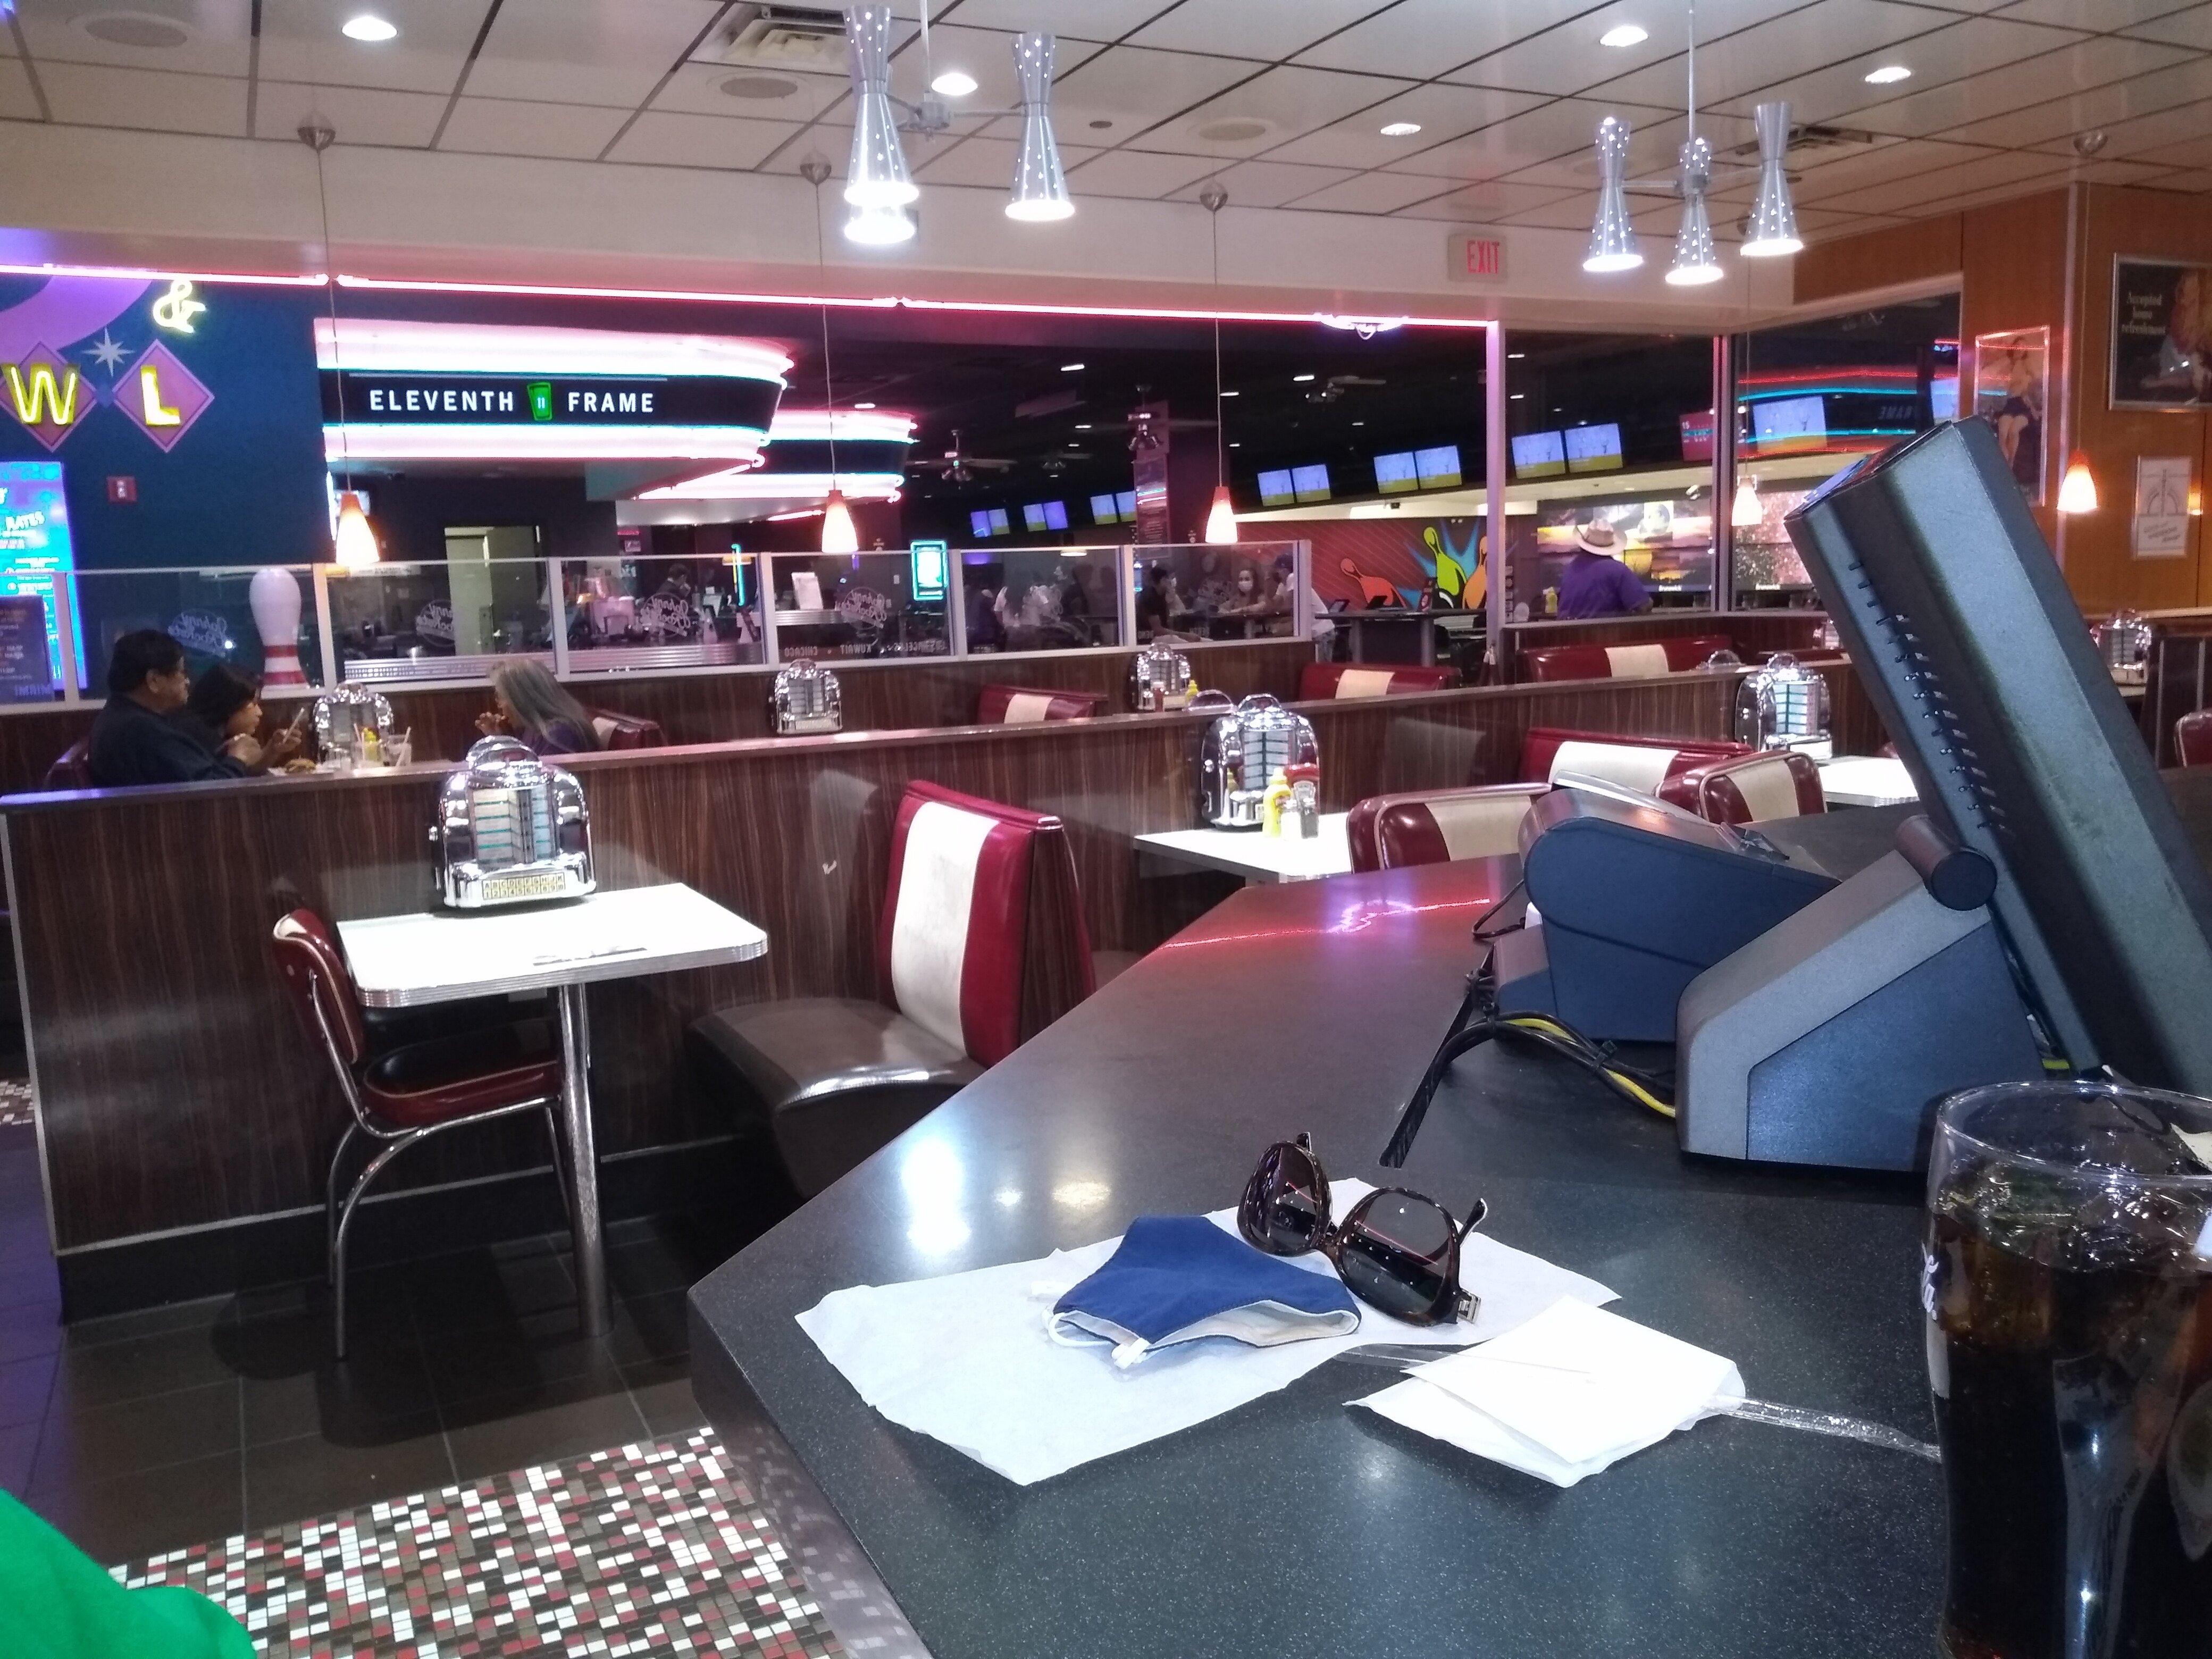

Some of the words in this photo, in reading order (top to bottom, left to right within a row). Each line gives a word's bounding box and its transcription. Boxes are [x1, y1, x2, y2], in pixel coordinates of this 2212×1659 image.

[1467, 240, 1500, 274] EXIT
[153, 279, 206, 334] &
[370, 389, 514, 412] ELEVENTH
[568, 391, 654, 413] FRAME
